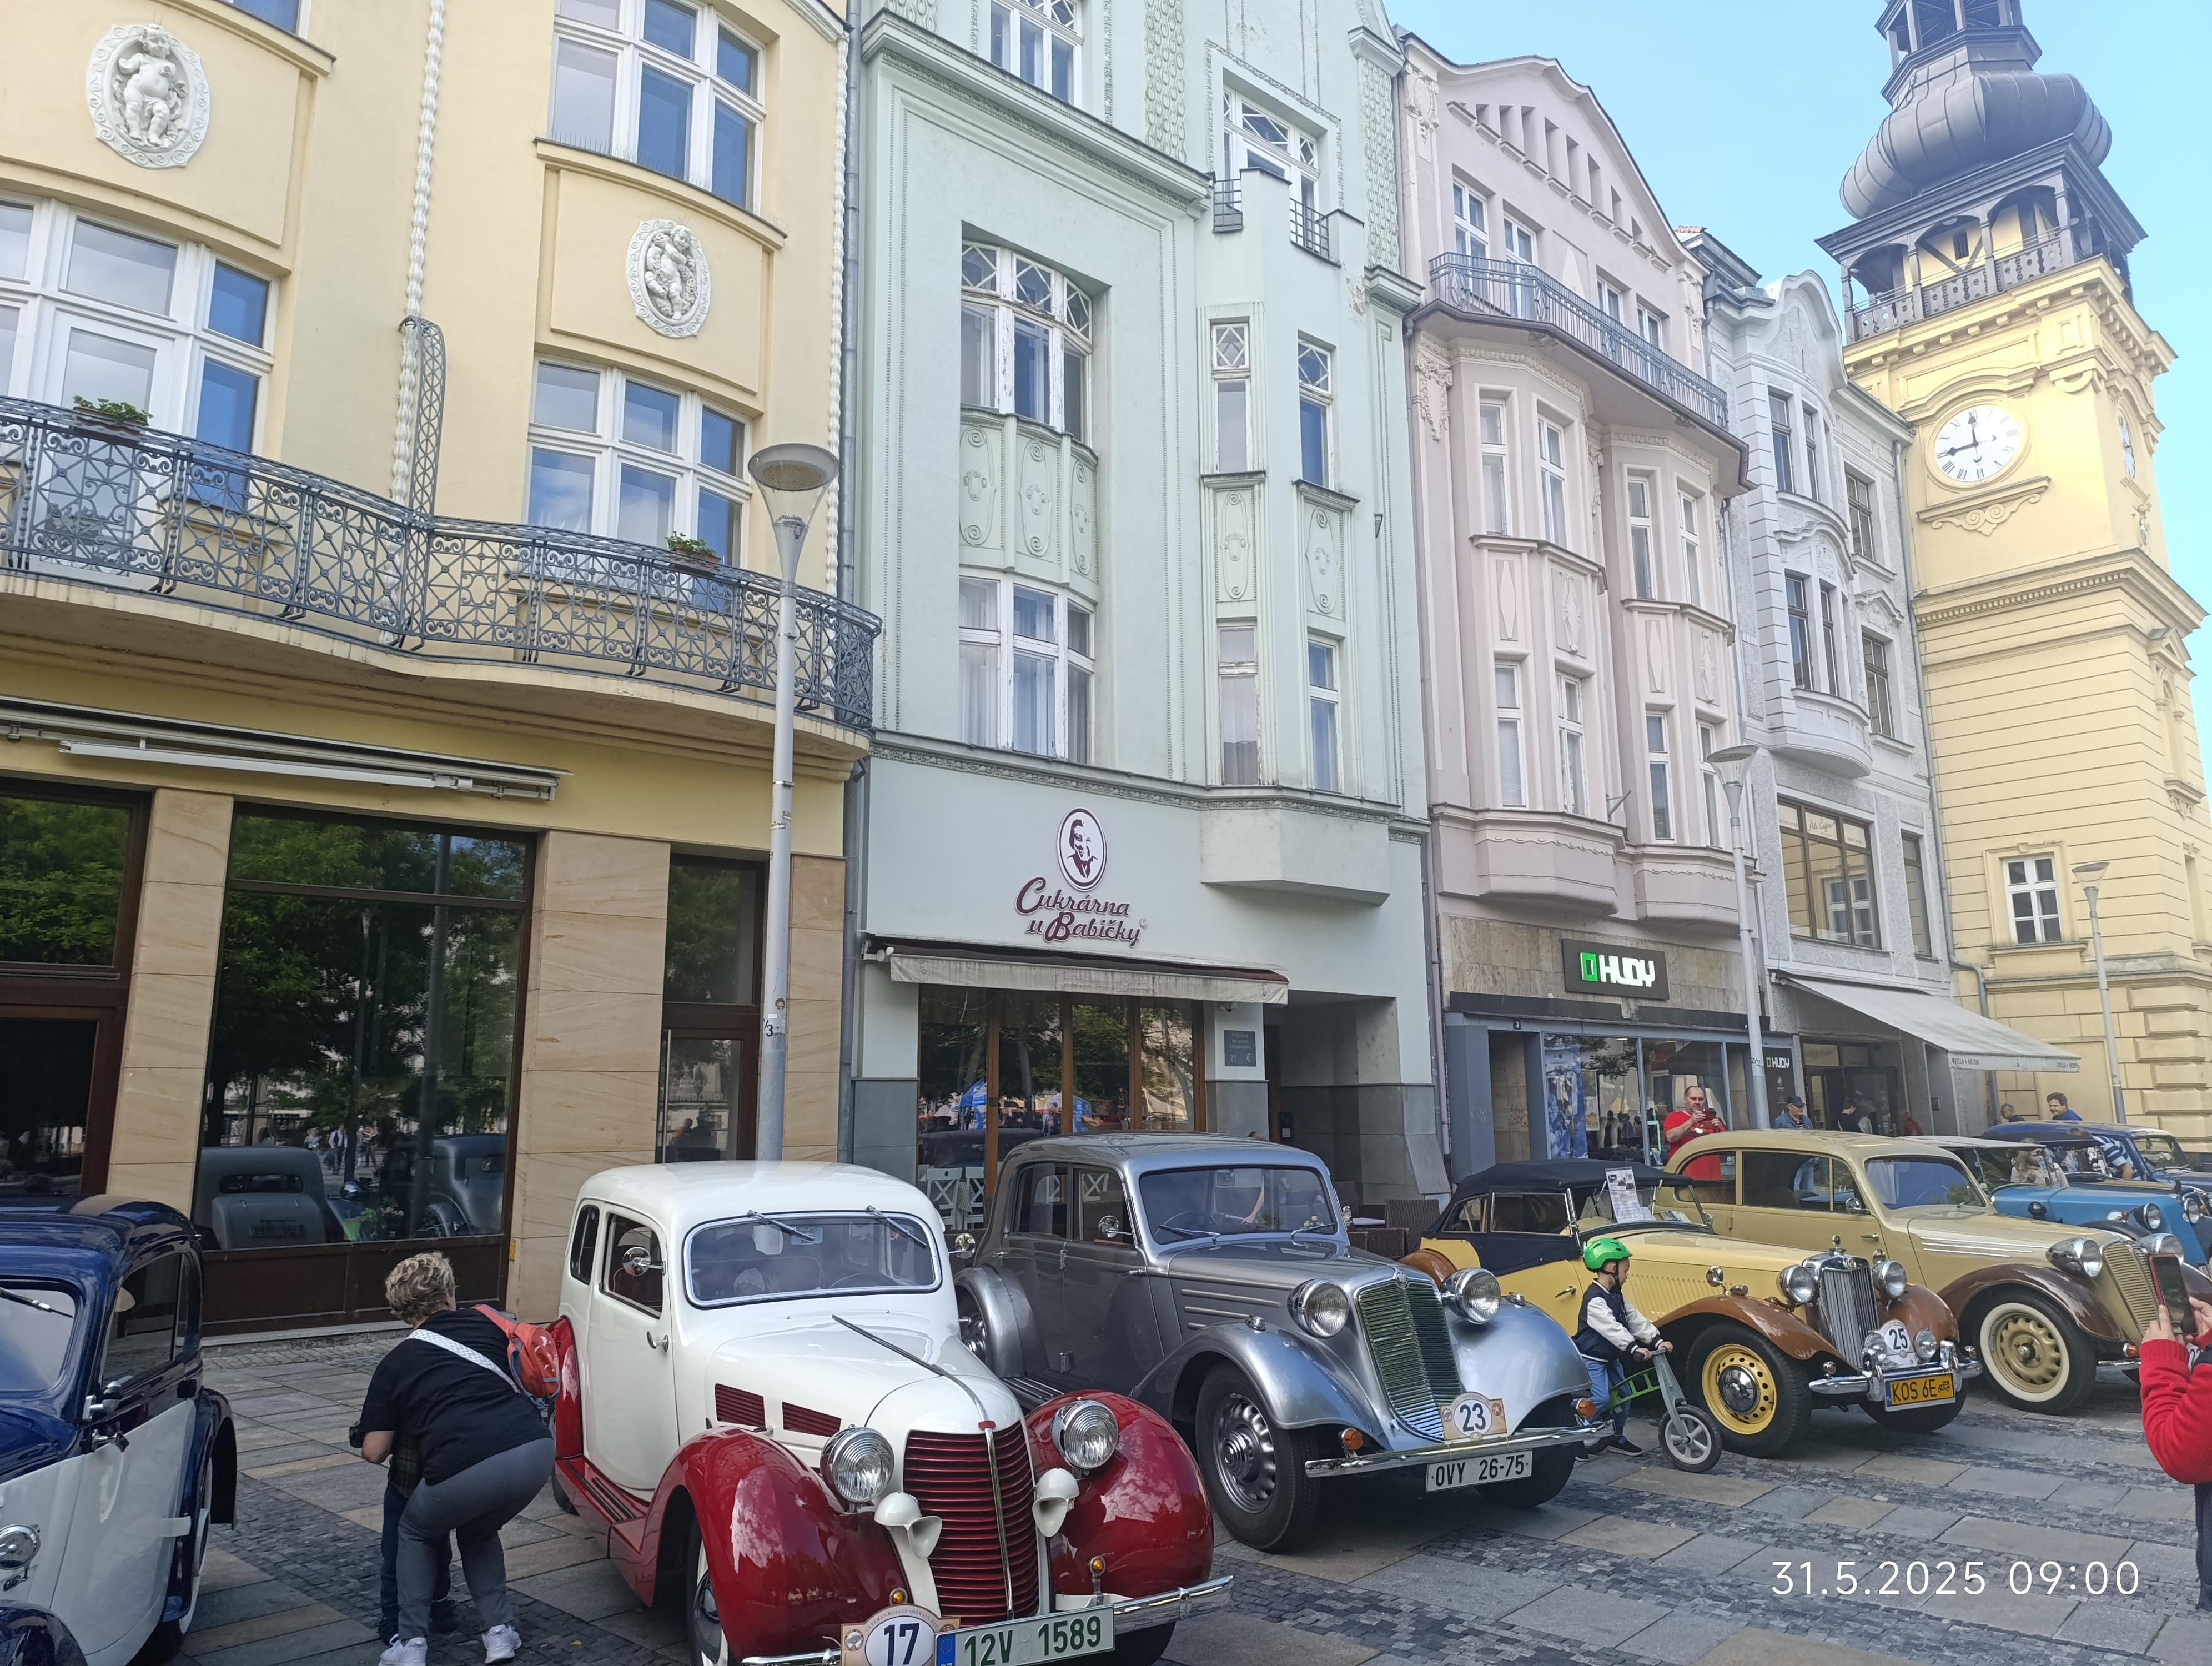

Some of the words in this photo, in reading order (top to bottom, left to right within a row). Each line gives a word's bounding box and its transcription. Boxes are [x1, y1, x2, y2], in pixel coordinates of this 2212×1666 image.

[1015, 876, 1130, 916] Cukrárna
[1026, 920, 1044, 933] u
[1044, 911, 1142, 947] Babičky
[1599, 954, 1656, 987] HUDY
[1771, 1057, 1790, 1068] HUDY
[1889, 1328, 1908, 1350] 25
[1892, 1381, 1918, 1402] KOS
[1922, 1379, 1937, 1397] 6E
[1460, 1403, 1486, 1432] 23
[1436, 1462, 1465, 1487] OVY
[1479, 1454, 1525, 1481] 26-75
[884, 1623, 920, 1666] 17
[964, 1629, 1013, 1666] 12V
[1037, 1615, 1101, 1656] 1589
